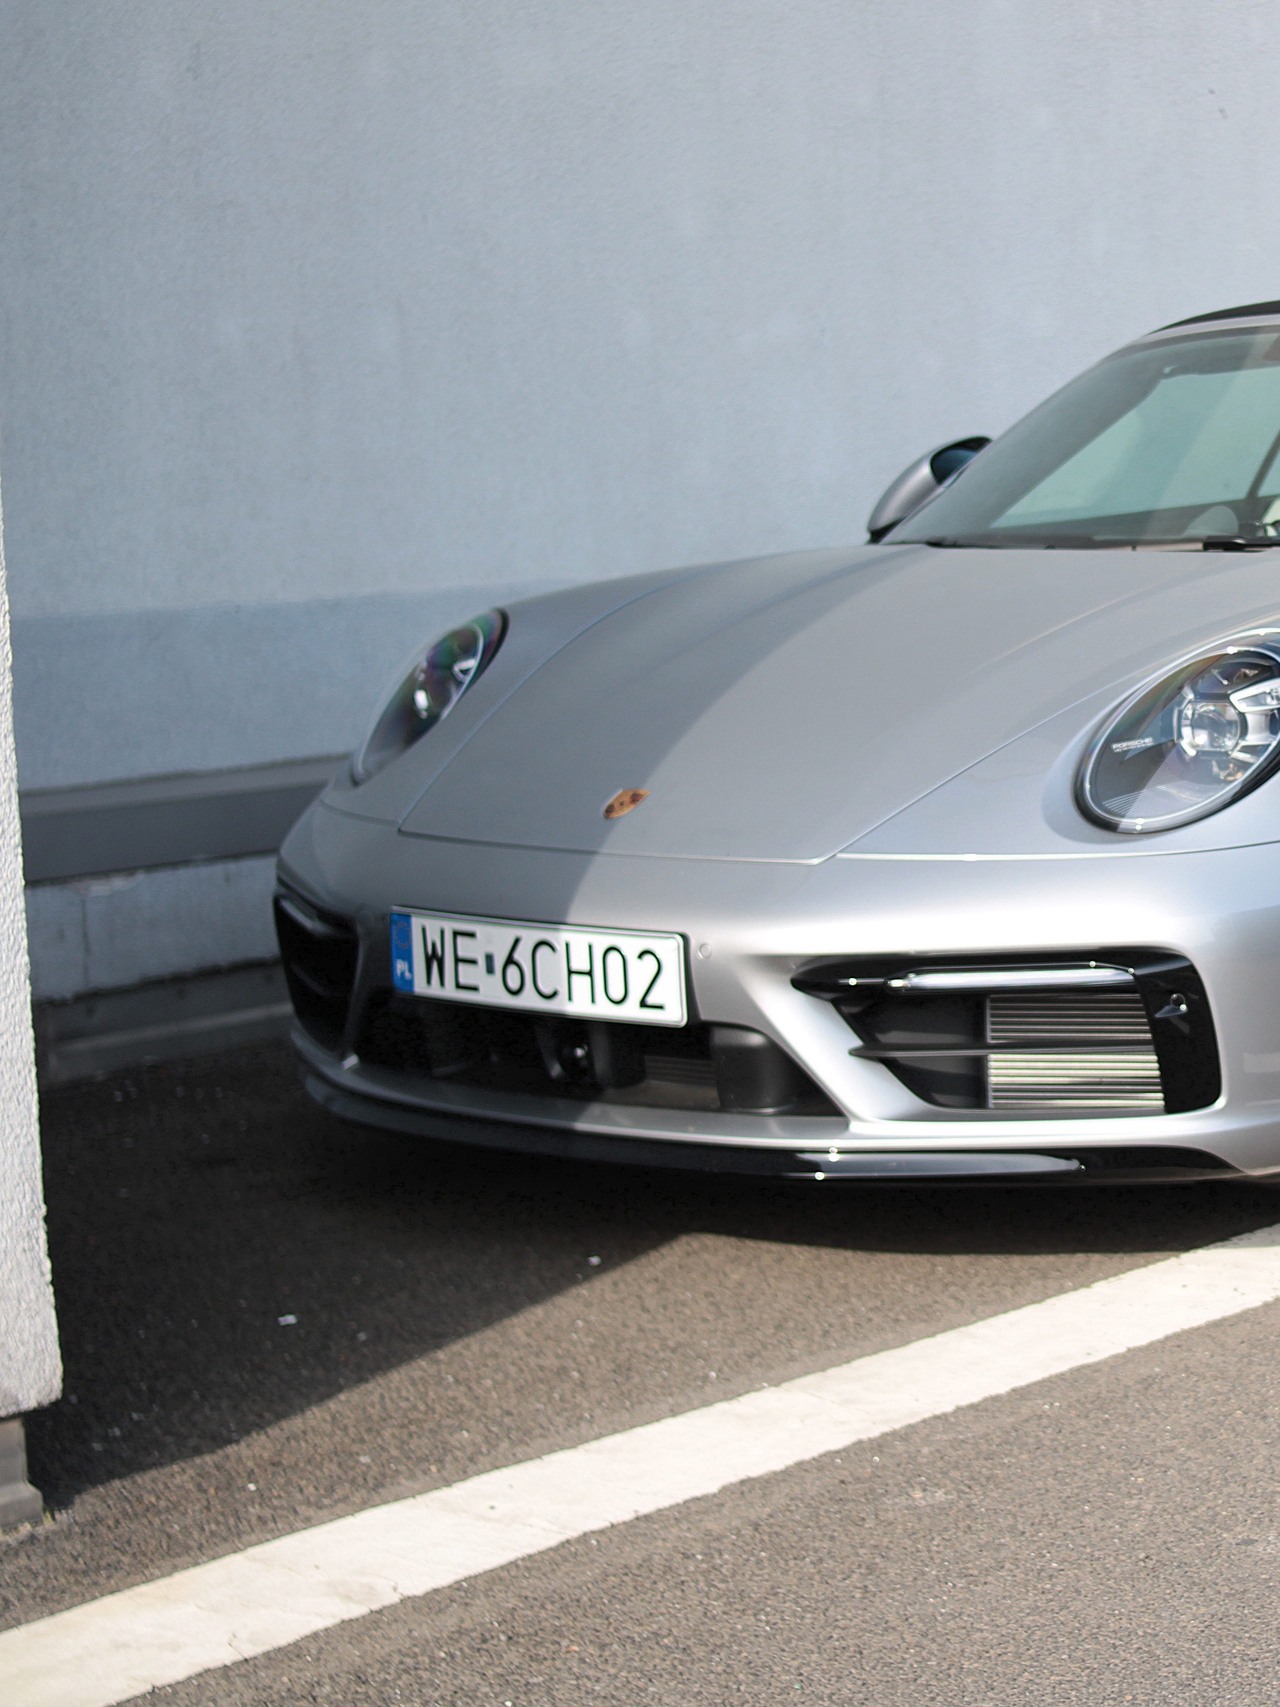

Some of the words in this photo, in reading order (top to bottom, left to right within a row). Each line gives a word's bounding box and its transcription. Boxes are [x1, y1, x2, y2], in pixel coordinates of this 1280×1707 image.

[396, 959, 412, 980] PL
[421, 924, 480, 993] WE
[501, 936, 665, 1010] 6CH02
